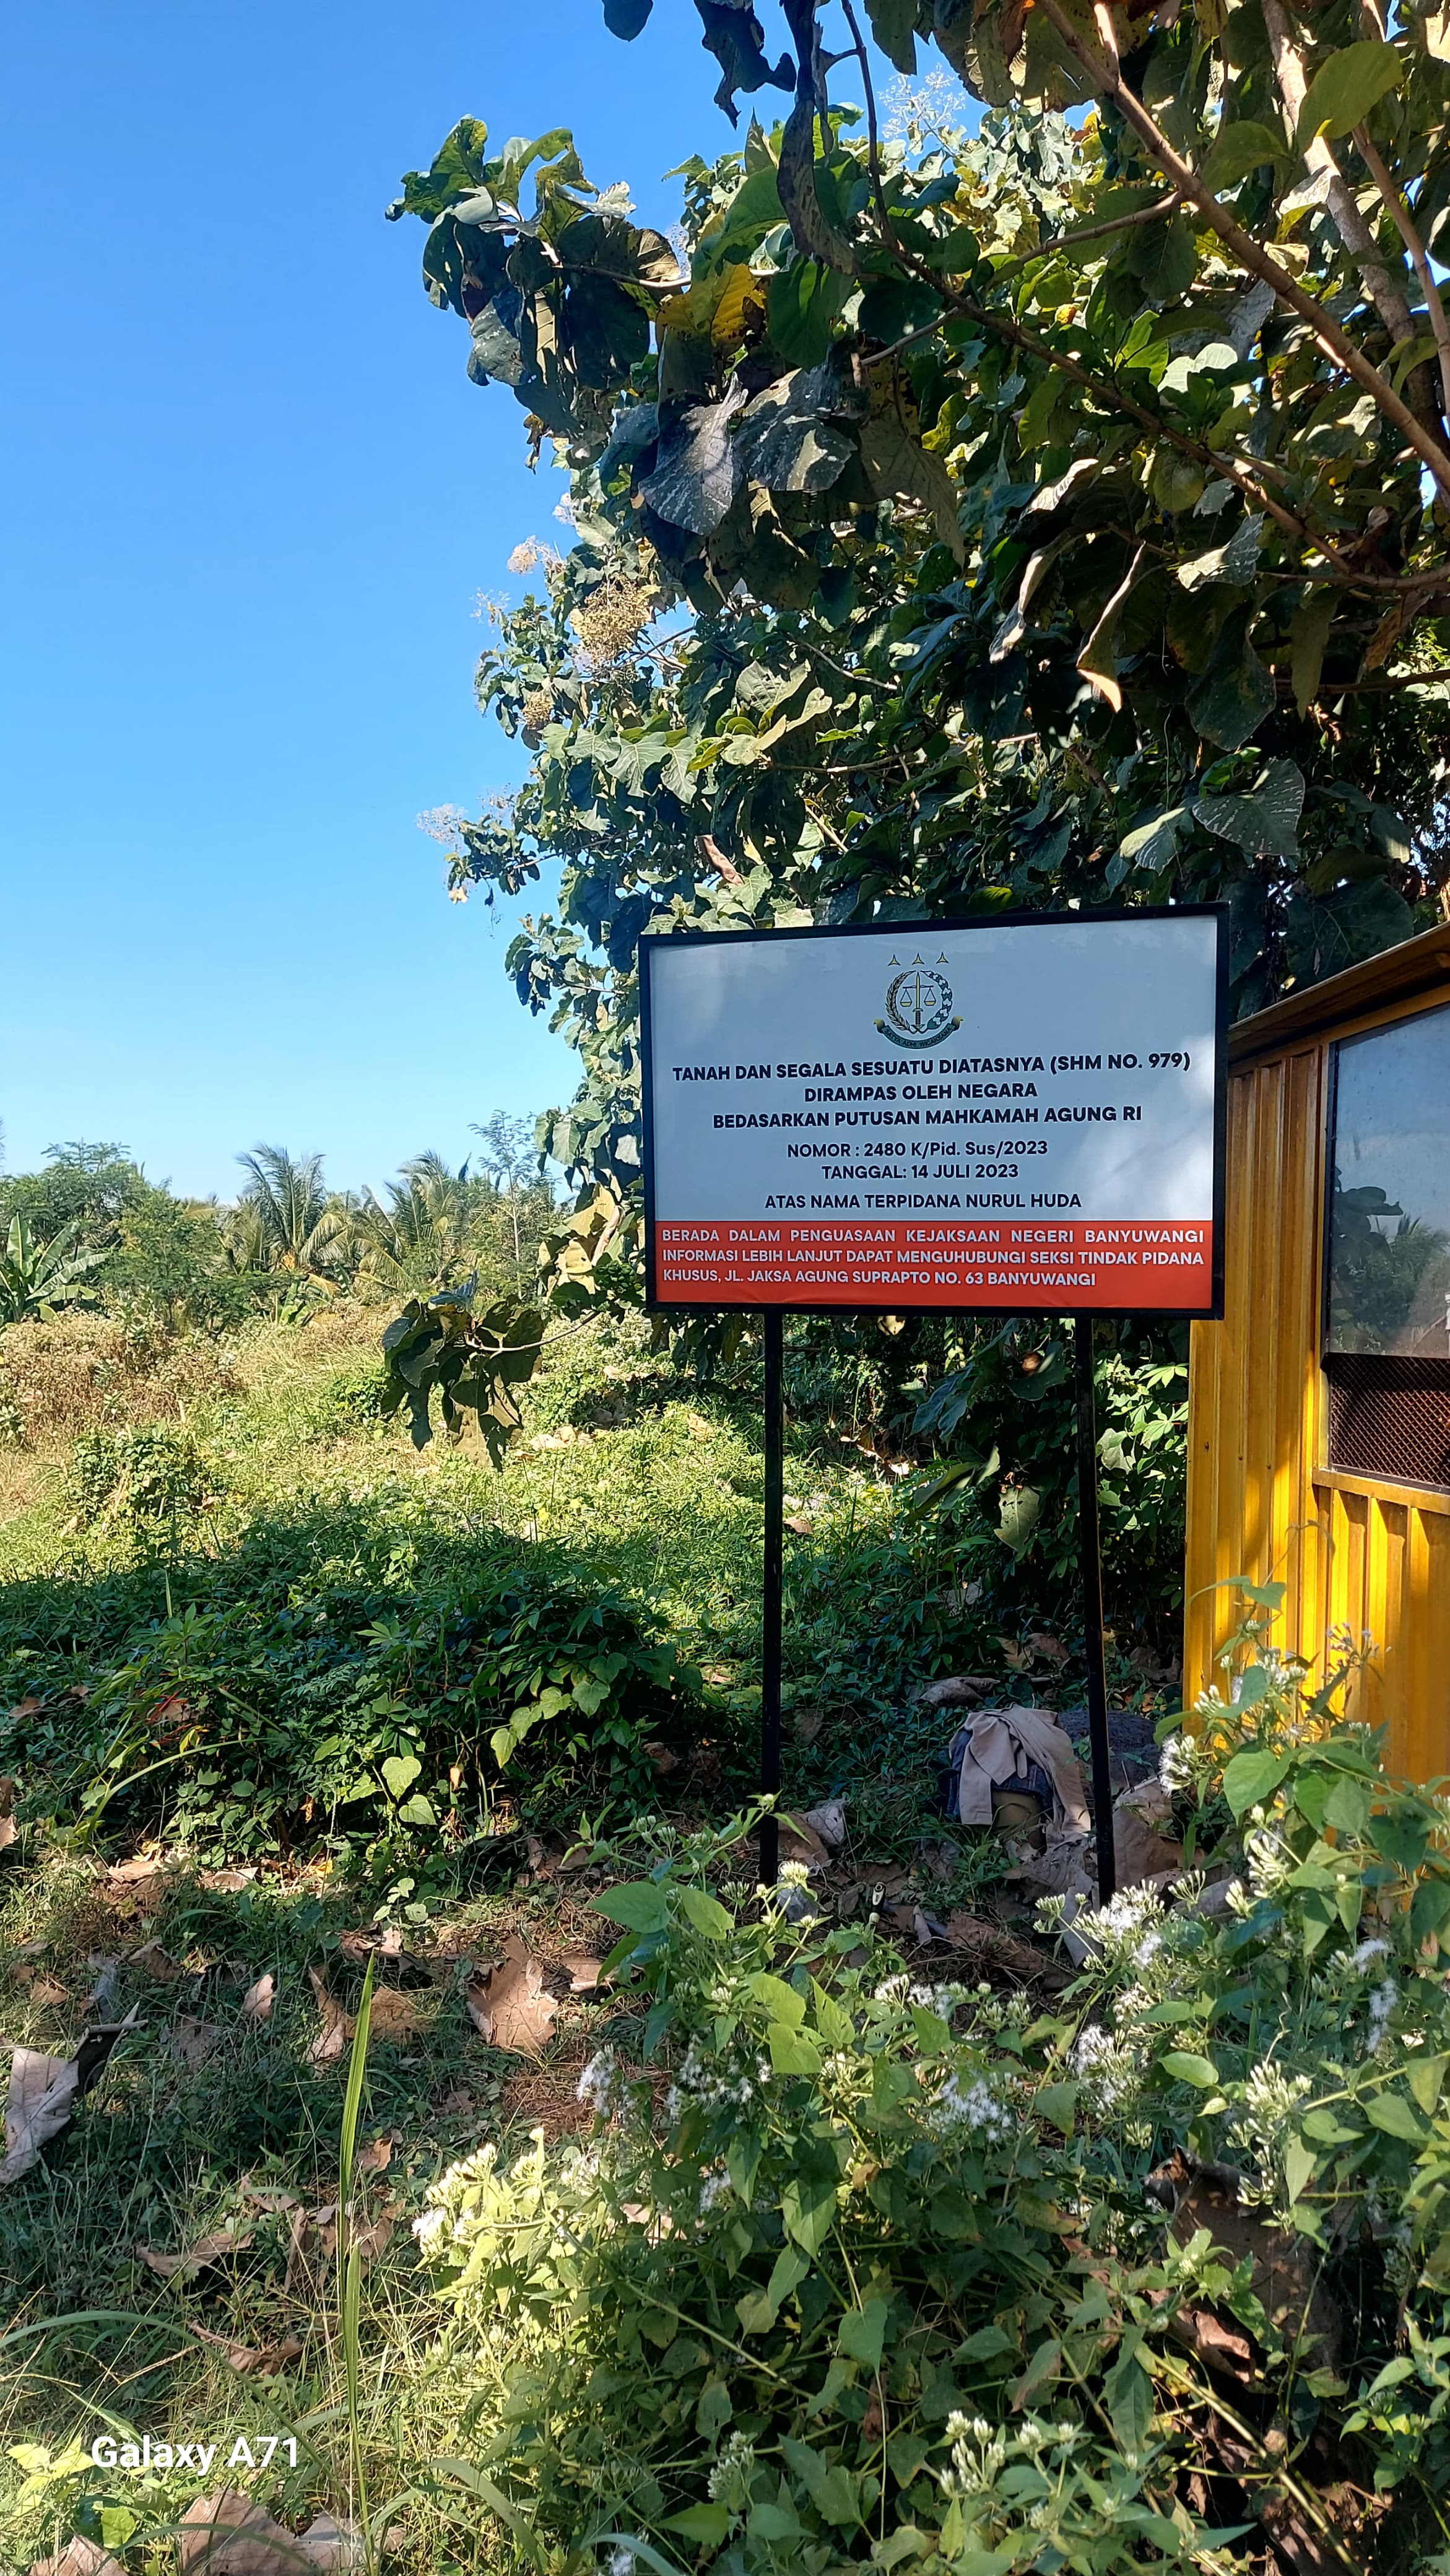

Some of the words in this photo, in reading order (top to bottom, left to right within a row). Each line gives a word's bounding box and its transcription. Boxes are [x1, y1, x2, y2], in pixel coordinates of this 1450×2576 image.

[884, 1029, 901, 1043] SATYA
[902, 1040, 917, 1048] ADHI
[919, 1027, 952, 1048] WICAKSANA
[672, 1066, 730, 1081] TANAH
[735, 1064, 771, 1080] DAN
[776, 1062, 847, 1079] SEGALA
[851, 1060, 934, 1076] SESUATU
[939, 1056, 1045, 1074] DIATASNYA
[1050, 1055, 1101, 1076] (SHM
[1108, 1053, 1143, 1069] NO.
[1148, 1051, 1191, 1072] 979)
[804, 1086, 897, 1102] DIRAMPAS
[902, 1084, 952, 1100] OLEH
[958, 1082, 1038, 1099] NEGARA
[713, 1112, 829, 1129] BEDASARKAN
[835, 1110, 920, 1126] PUTUSAN
[926, 1108, 1039, 1125] MAHKAMAH
[1043, 1106, 1117, 1123] AGUNG
[1123, 1105, 1142, 1121] RI
[788, 1143, 851, 1158] NOMOR
[864, 1142, 906, 1157] 2480
[911, 1141, 960, 1160] K/Pid.
[965, 1140, 1048, 1159] Sus/2023
[821, 1165, 907, 1180] TANGGAL:
[911, 1164, 929, 1179] 14
[932, 1164, 970, 1178] JULI
[975, 1164, 1018, 1178] 2023
[765, 1194, 806, 1209] ATAS
[810, 1194, 861, 1209] NAMA
[864, 1194, 962, 1208] TERPIDANA
[966, 1193, 1026, 1208] NURUL
[1031, 1193, 1082, 1208] HUDA
[662, 1229, 719, 1242] BERADA
[729, 1229, 780, 1242] DALAM
[791, 1229, 895, 1242] PENGUASAAN
[906, 1230, 1000, 1242] KEJAKSAAN
[1011, 1230, 1074, 1243] NEGERI
[1085, 1229, 1204, 1243] BANYUWANGI
[663, 1249, 738, 1261] INFORMASI
[742, 1250, 783, 1262] LEBIH
[787, 1250, 843, 1262] LANJUT
[846, 1250, 893, 1263] DAPAT
[897, 1250, 1025, 1264] MENGUHUBUNGI
[1030, 1251, 1074, 1264] SEKSI
[1077, 1251, 1138, 1264] TINDAK
[1142, 1251, 1204, 1265] PIDANA
[664, 1269, 721, 1283] KHUSUS,
[724, 1269, 744, 1282] JL.
[747, 1270, 792, 1282] JAKSA
[795, 1270, 848, 1282] AGUNG
[853, 1271, 931, 1284] SUPRAPTO
[935, 1271, 962, 1284] NO.
[965, 1272, 984, 1284] 63
[988, 1272, 1095, 1286] BANYUWANGI
